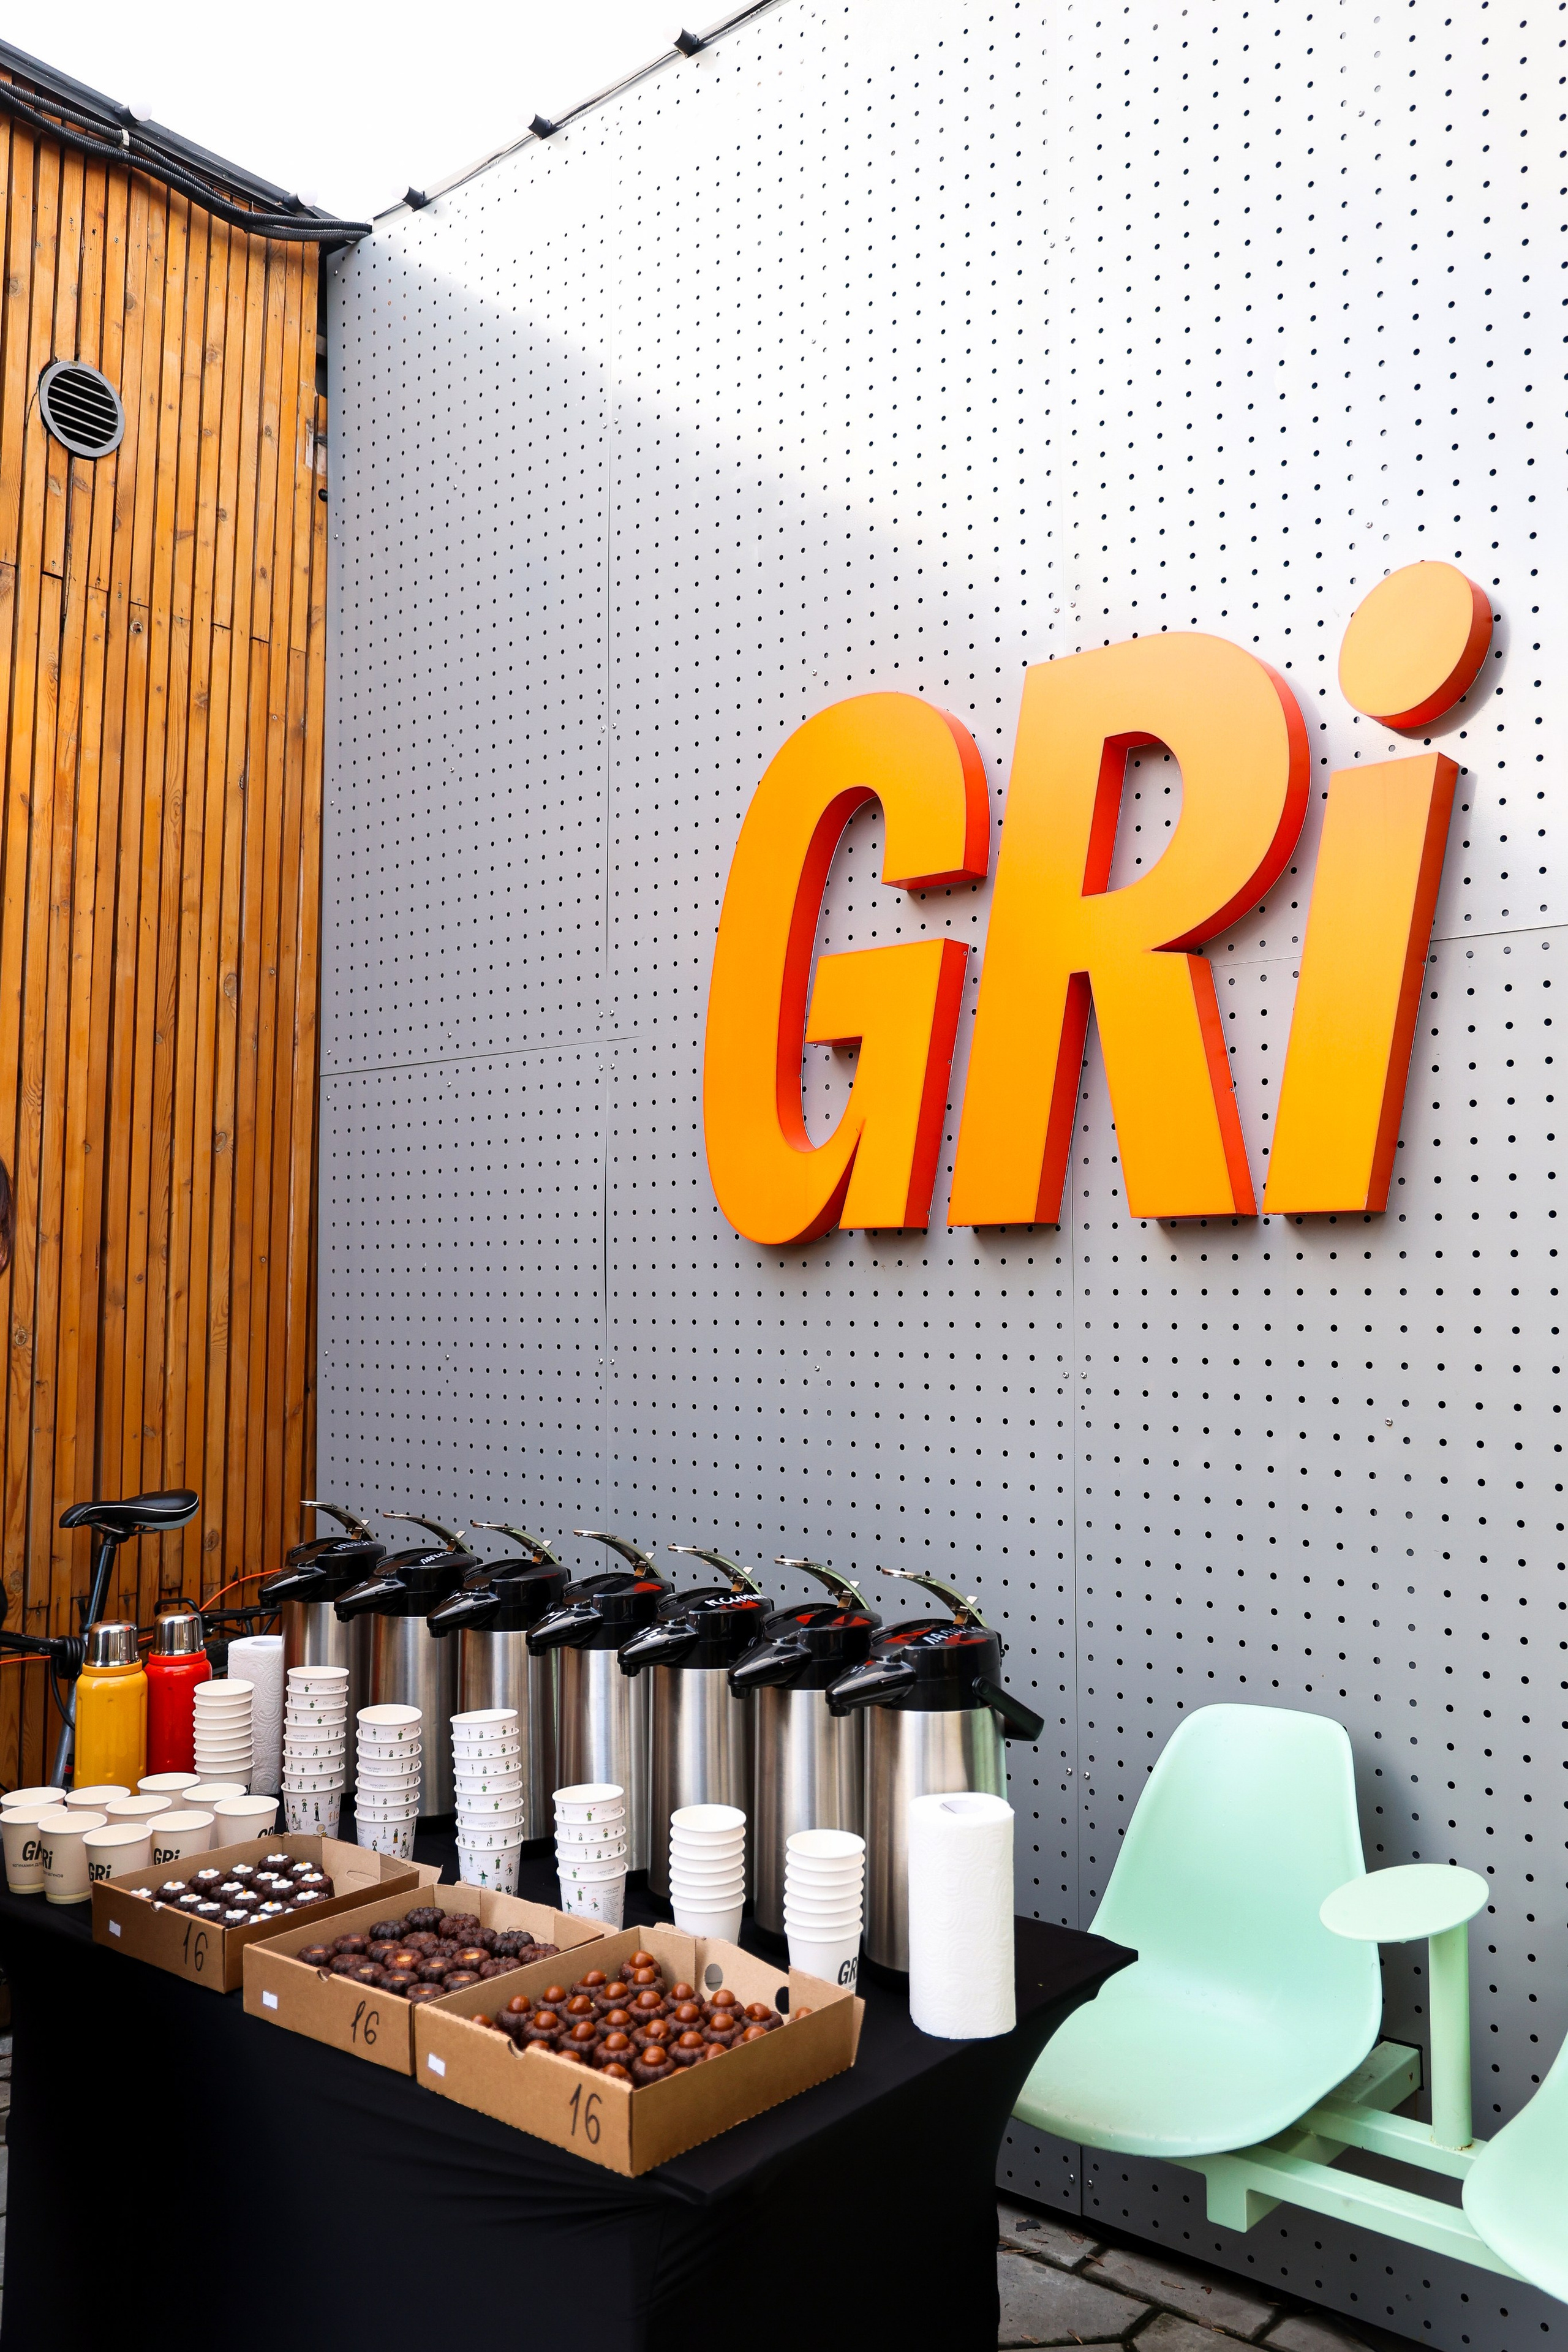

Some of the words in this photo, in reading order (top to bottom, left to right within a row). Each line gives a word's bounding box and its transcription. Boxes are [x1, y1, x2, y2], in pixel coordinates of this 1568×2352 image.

[703, 561, 1493, 1245] GRi
[88, 1861, 112, 1882] GRi
[153, 1847, 181, 1866] GRi
[183, 1921, 208, 1972] 16
[350, 2000, 379, 2045] 16
[569, 2082, 603, 2145] 16
